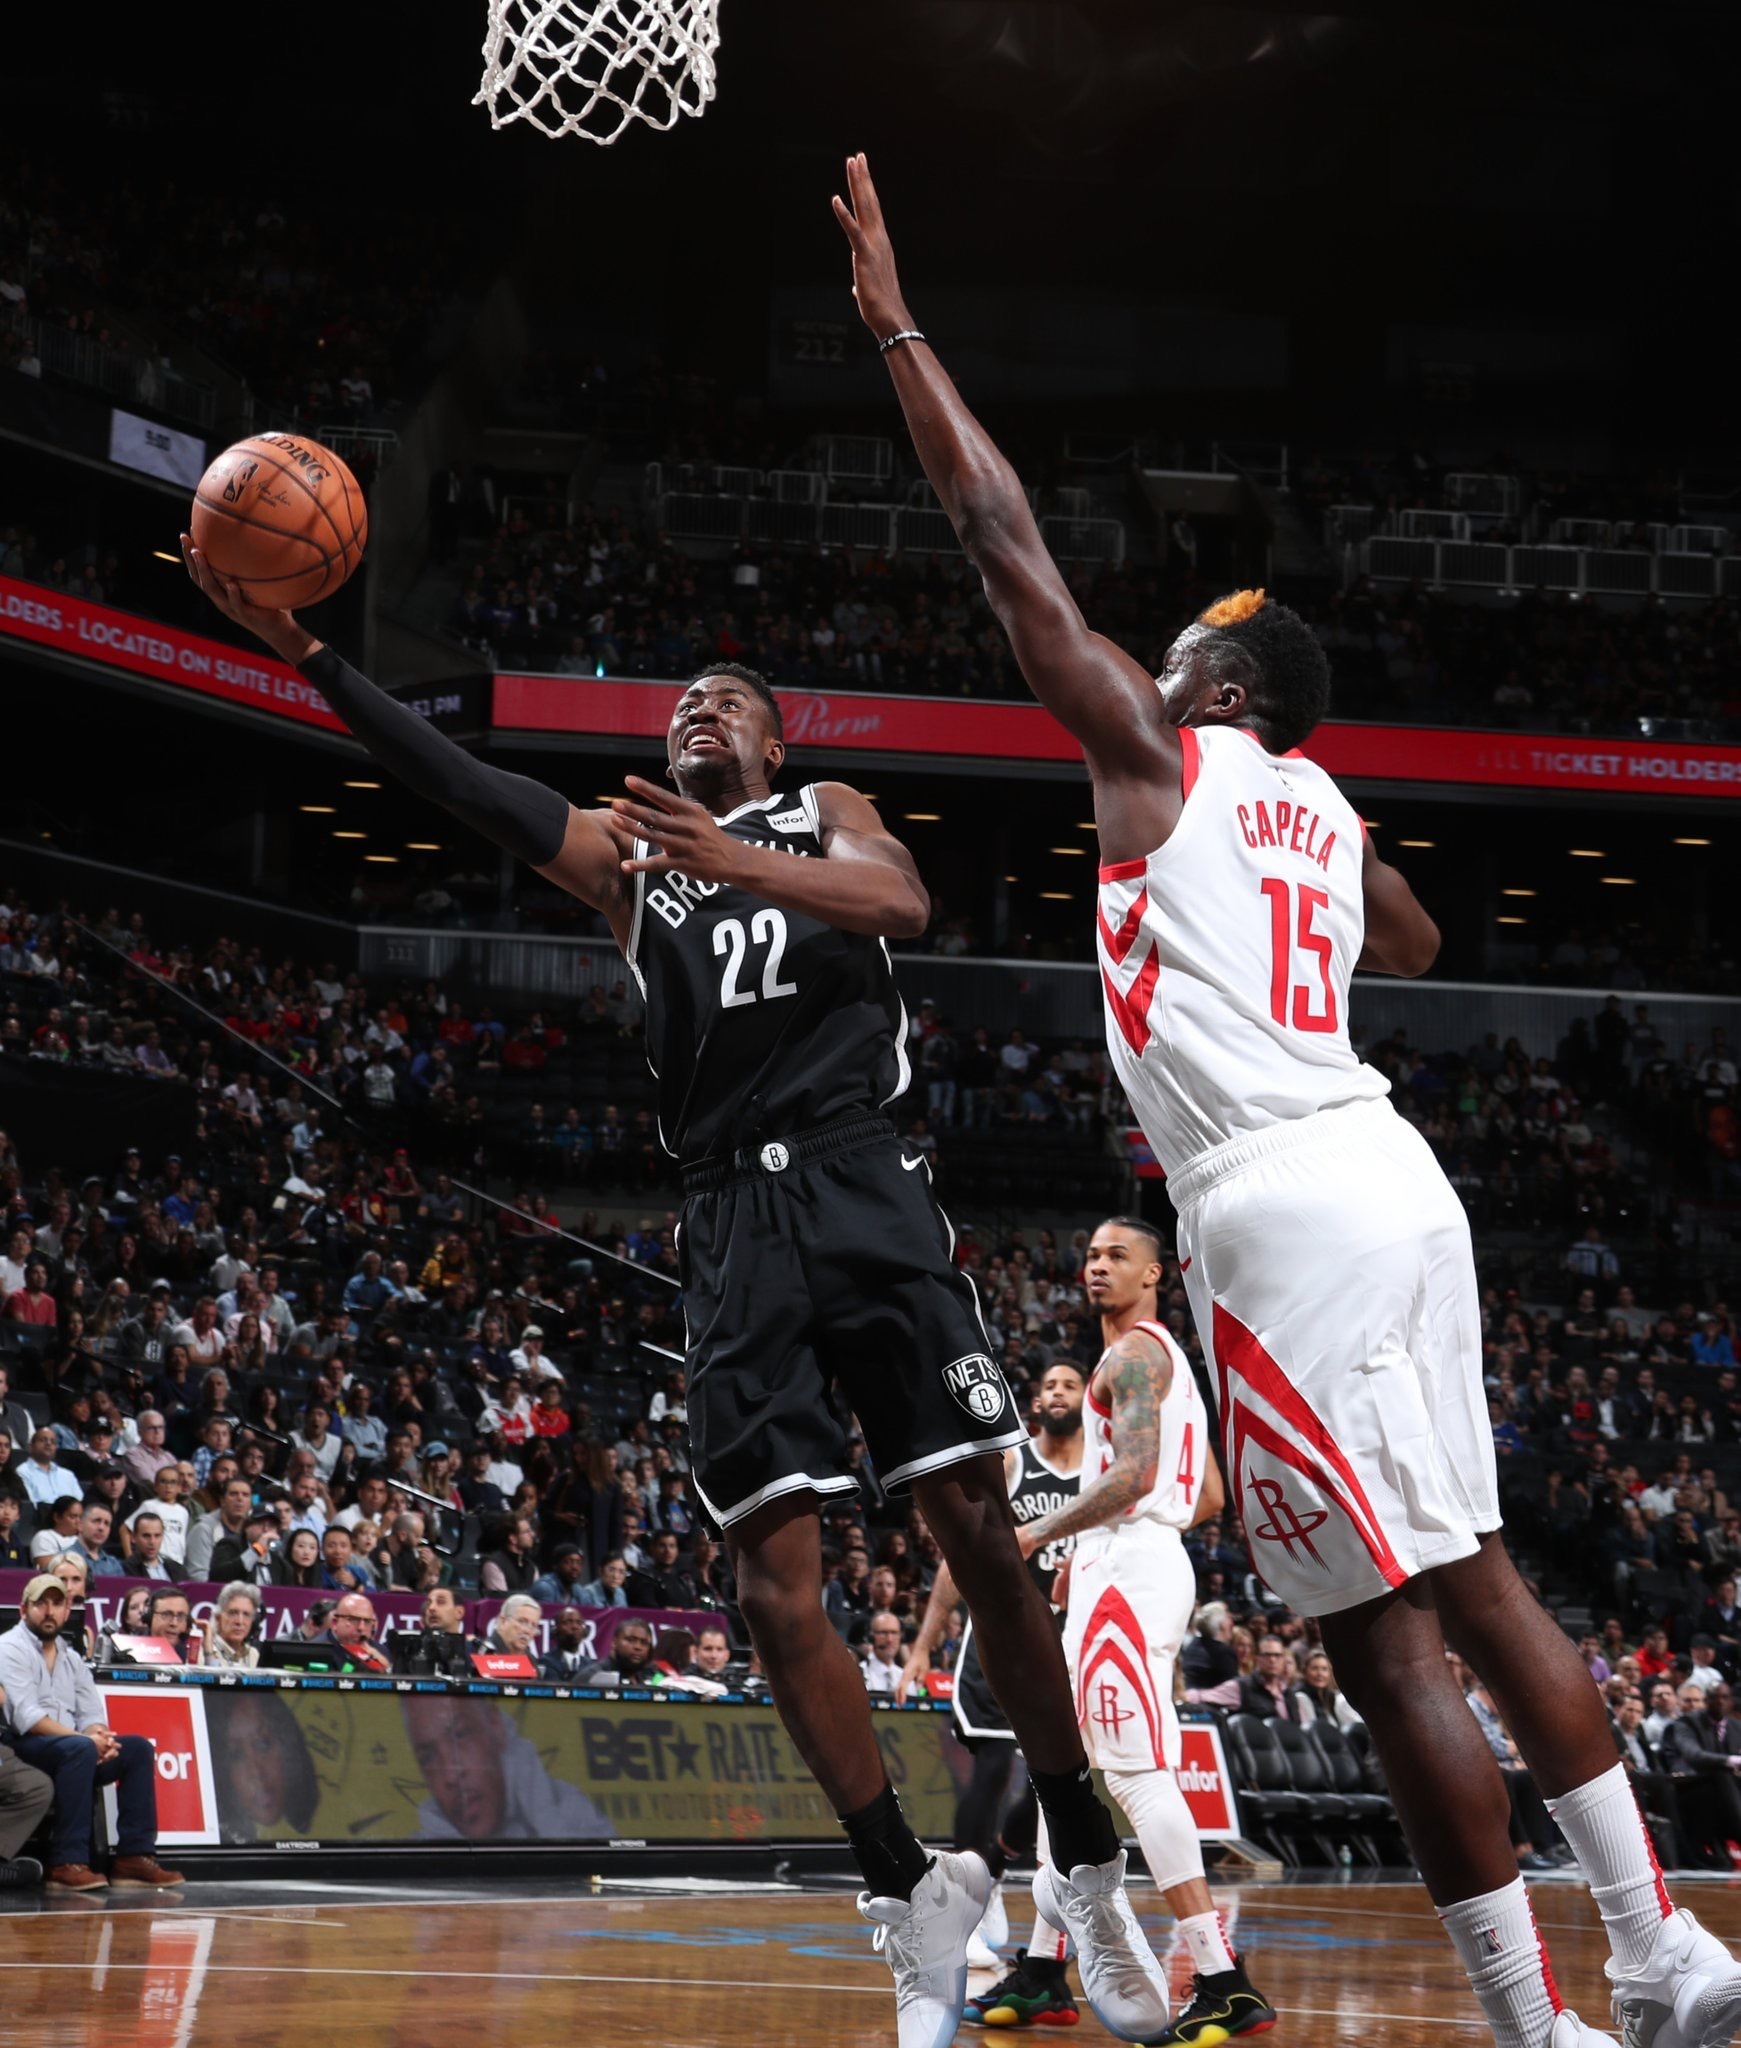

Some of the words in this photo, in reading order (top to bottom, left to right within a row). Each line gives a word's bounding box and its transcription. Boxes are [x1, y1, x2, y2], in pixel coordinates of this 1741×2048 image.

[79, 617, 175, 665] LOCATED
[178, 648, 211, 676] ON
[215, 659, 270, 695] SUITE
[434, 694, 462, 714] PM
[1530, 751, 1622, 777] TICKET
[1628, 758, 1741, 783] HOLDERS
[771, 814, 806, 827] infor
[1237, 800, 1336, 872] CAPELA
[712, 908, 798, 1008] 22
[1260, 877, 1338, 1033] 15
[947, 1357, 998, 1393] NETS
[1176, 1422, 1194, 1505] 4
[580, 1717, 673, 1781] BET
[703, 1721, 786, 1783] RATE
